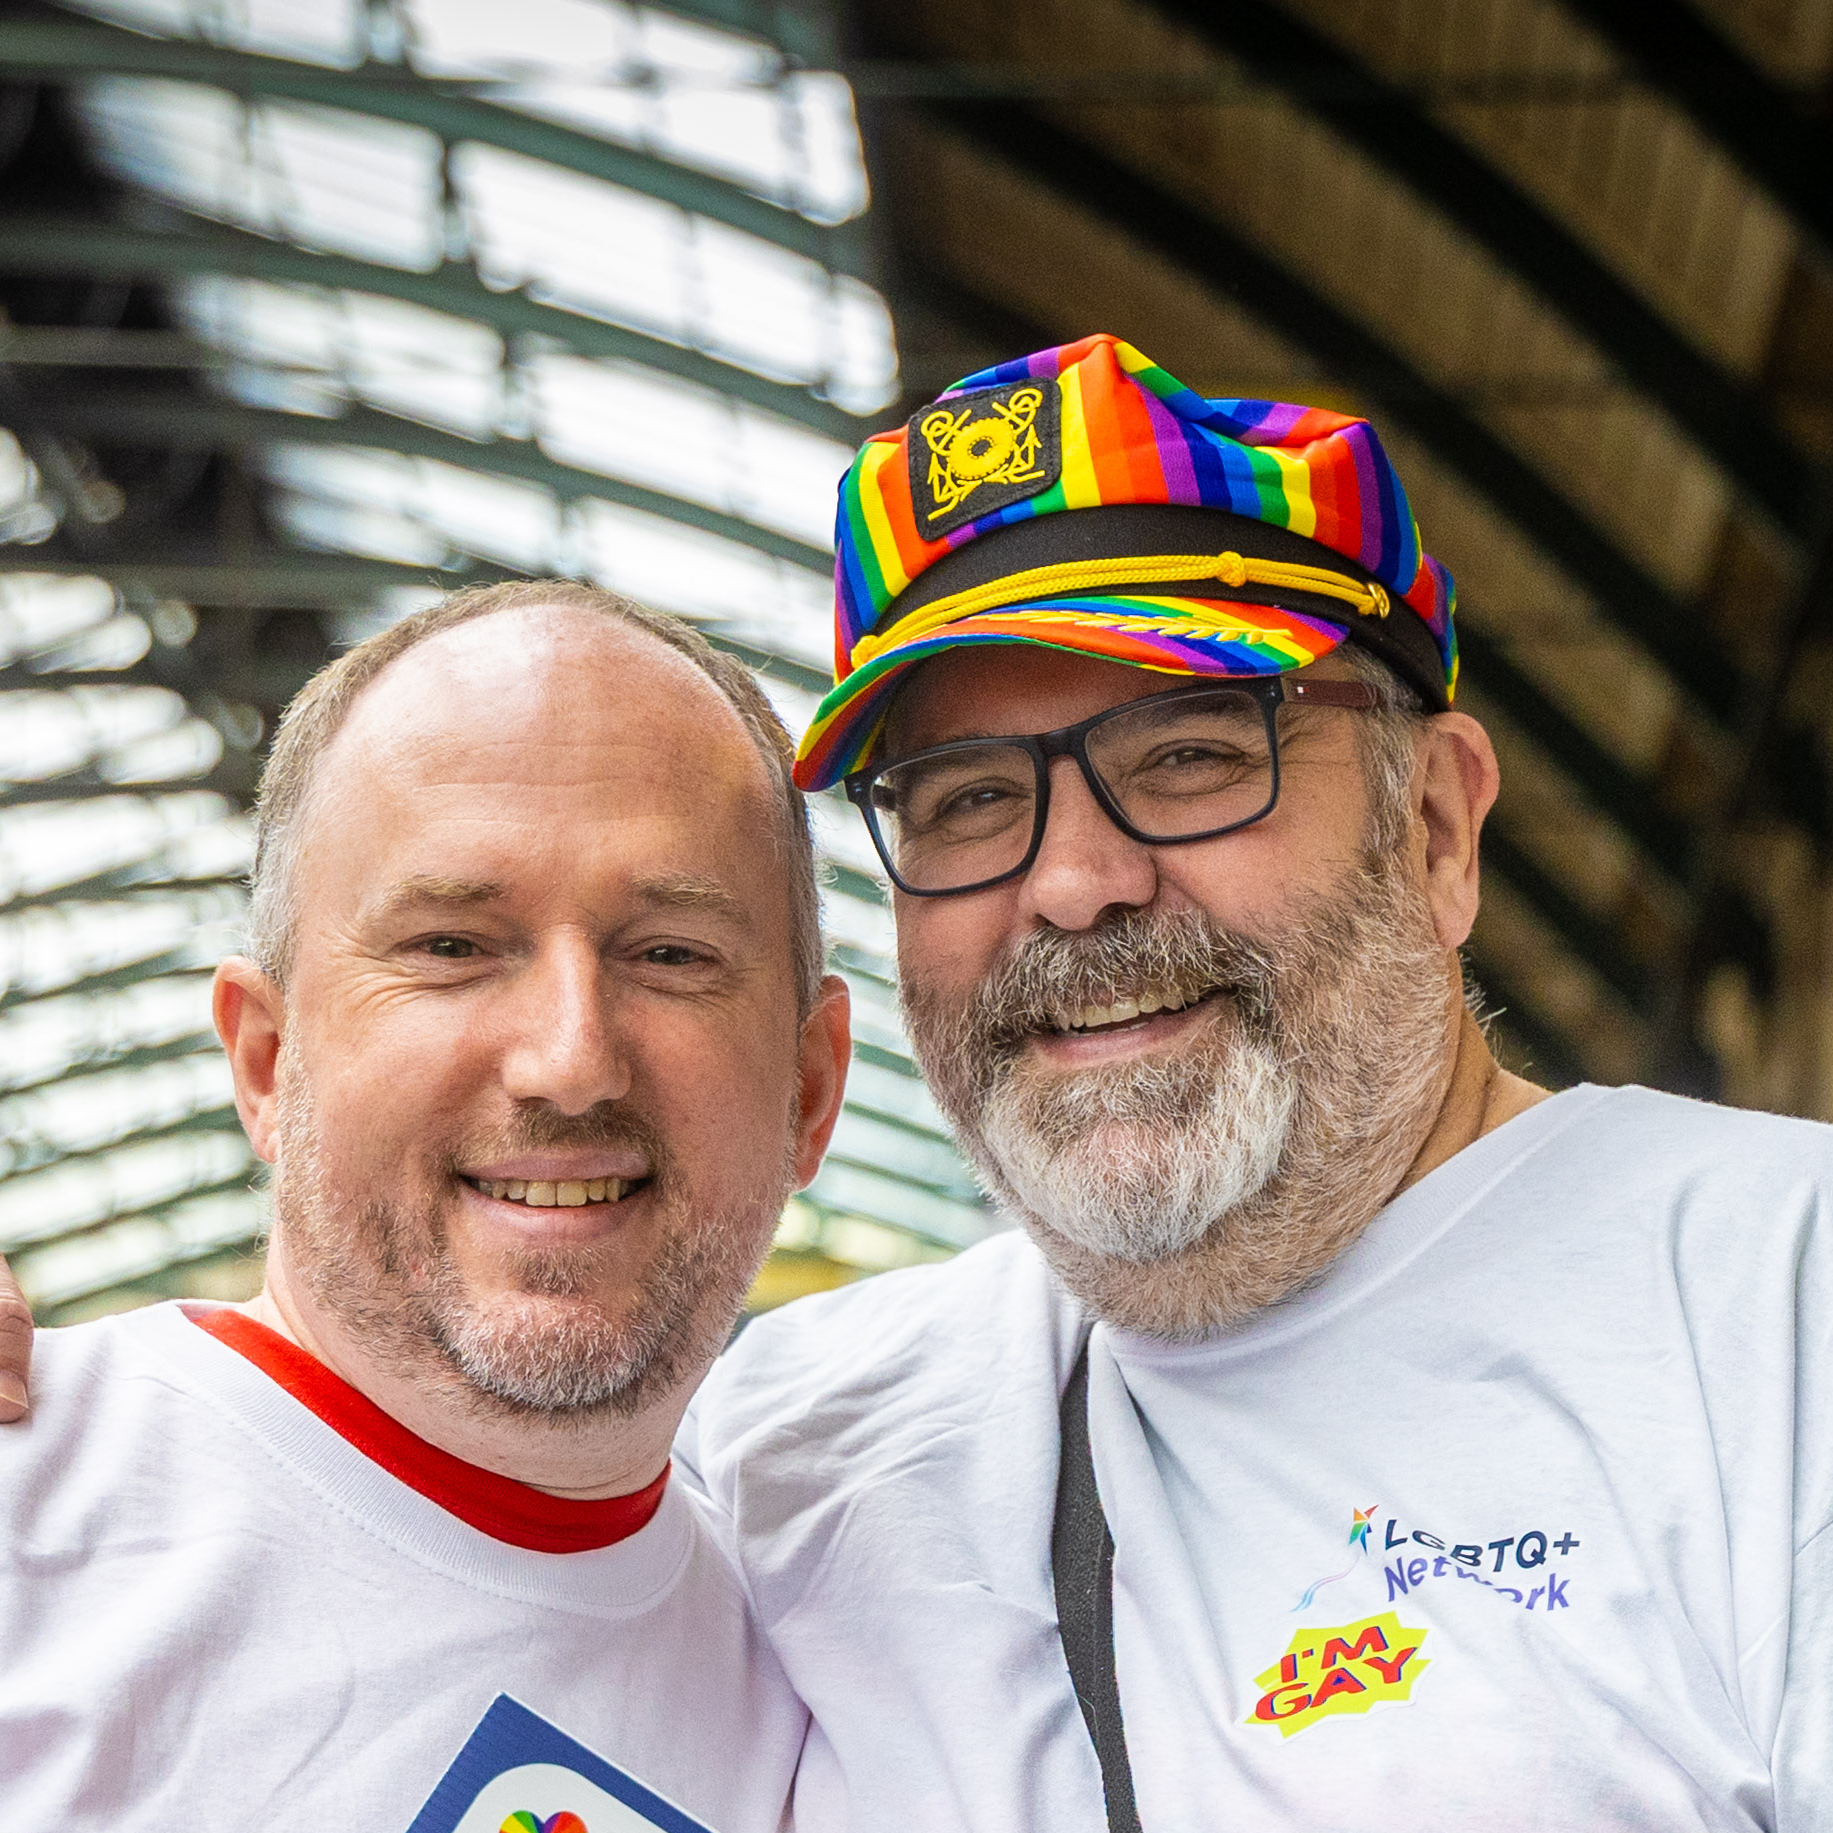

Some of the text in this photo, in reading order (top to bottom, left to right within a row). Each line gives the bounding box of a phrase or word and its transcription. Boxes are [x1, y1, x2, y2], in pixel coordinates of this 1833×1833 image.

[1385, 1519, 1580, 1573] LGBTQ+
[1384, 1556, 1571, 1611] Network
[1280, 1626, 1389, 1683] I'M
[1255, 1647, 1418, 1721] GAY
